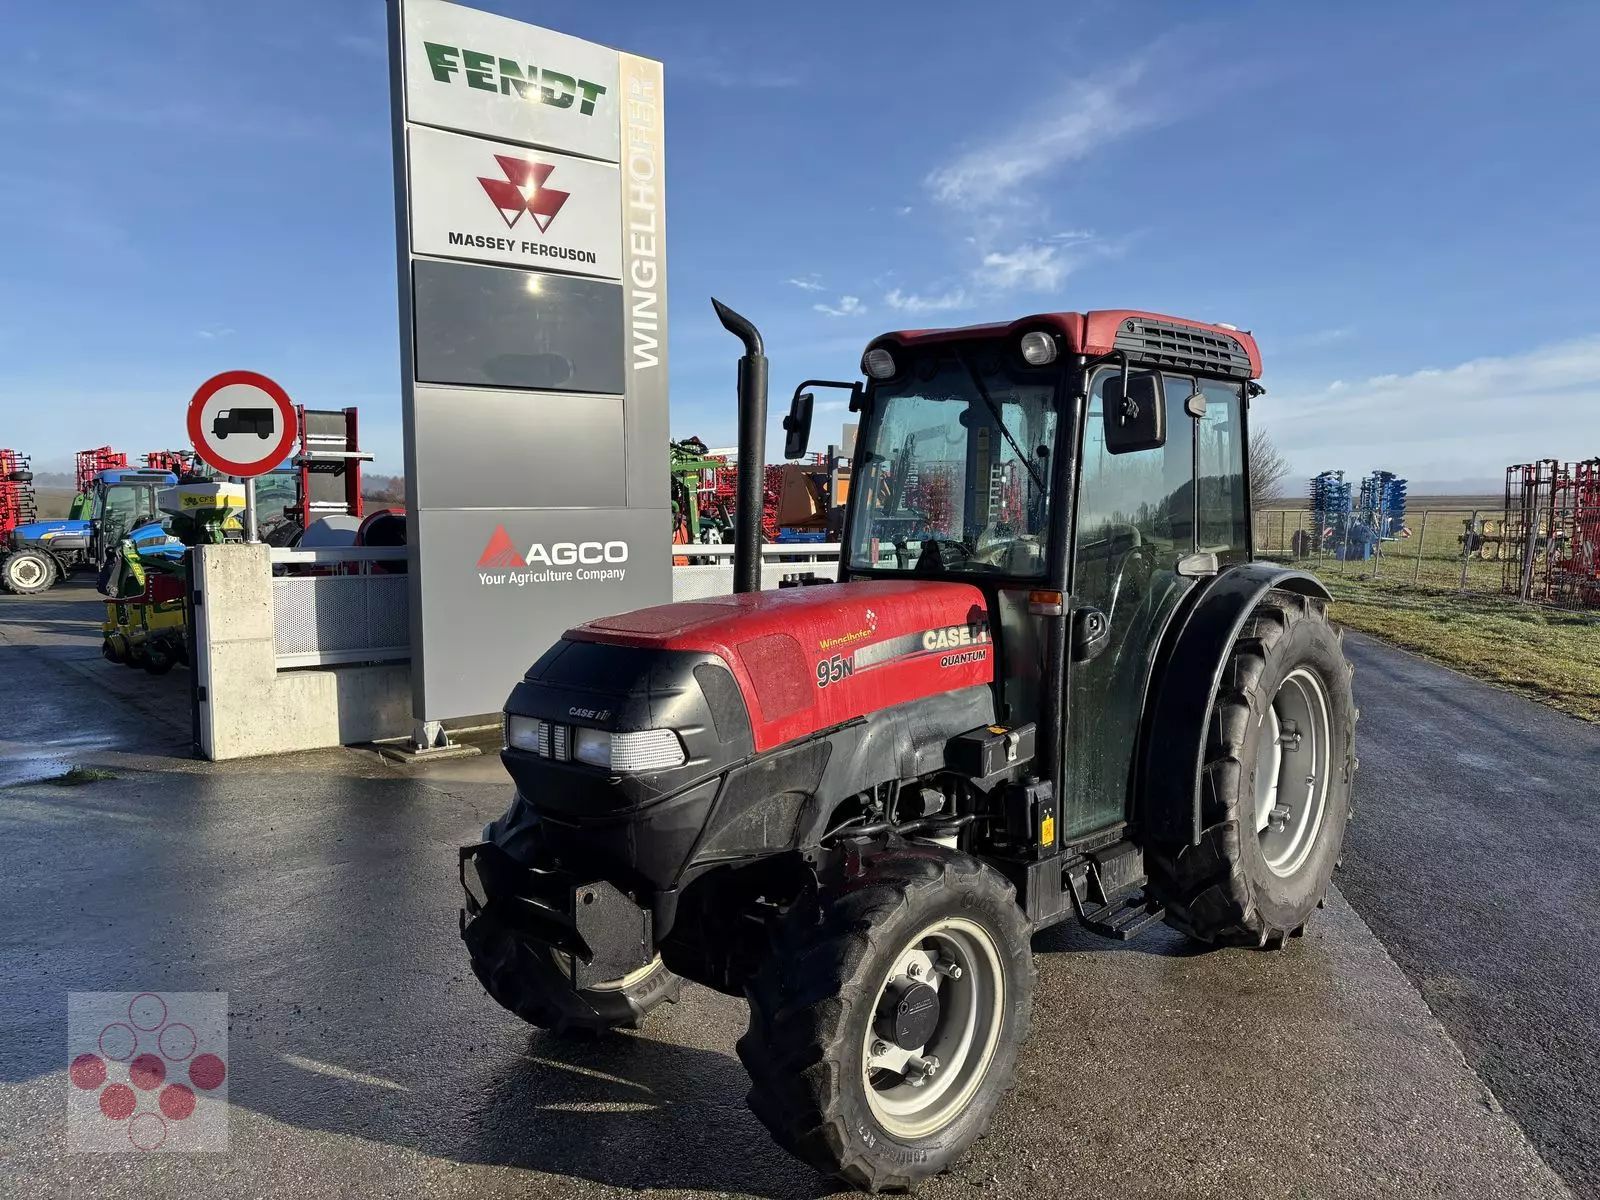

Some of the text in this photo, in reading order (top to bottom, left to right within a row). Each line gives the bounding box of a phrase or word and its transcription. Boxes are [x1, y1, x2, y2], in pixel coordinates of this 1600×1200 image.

[424, 41, 607, 117] FENDT
[630, 75, 659, 371] WINGELHOFER
[448, 231, 597, 264] MASSEY FERGUSON
[525, 540, 629, 566] AGCO
[479, 568, 626, 587] Your Agriculture Company
[923, 626, 970, 650] CASE
[816, 653, 853, 688] 95N
[940, 649, 986, 667] QUANTUM
[569, 706, 596, 719] CASE
